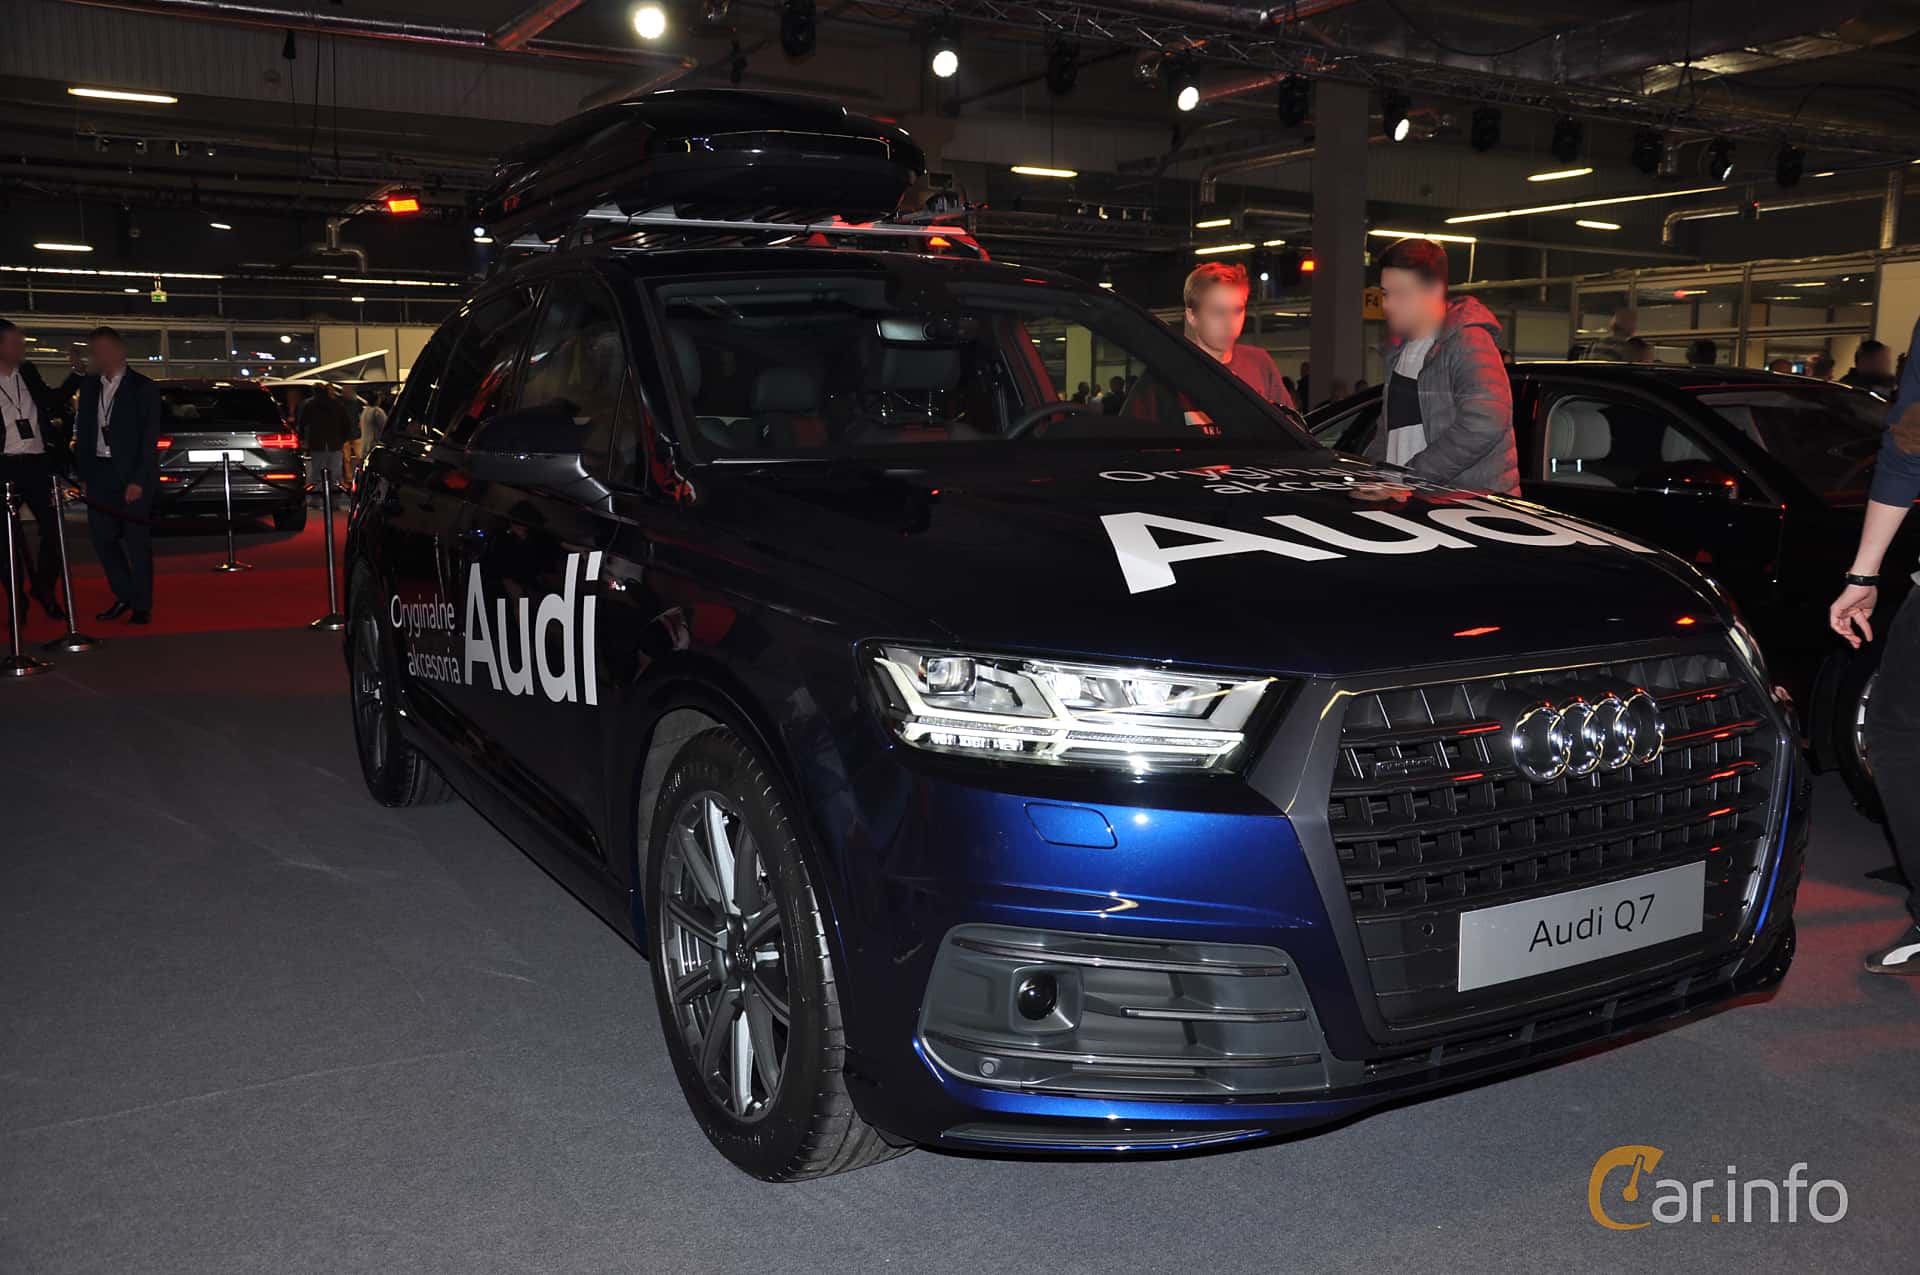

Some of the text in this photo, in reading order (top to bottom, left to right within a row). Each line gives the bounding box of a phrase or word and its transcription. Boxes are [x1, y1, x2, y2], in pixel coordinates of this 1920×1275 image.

[1100, 498, 1658, 594] Audi
[391, 594, 455, 637] Oryginalne
[465, 551, 602, 706] Audi
[407, 645, 461, 684] akcesoria
[1528, 893, 1655, 952] Audi Q7
